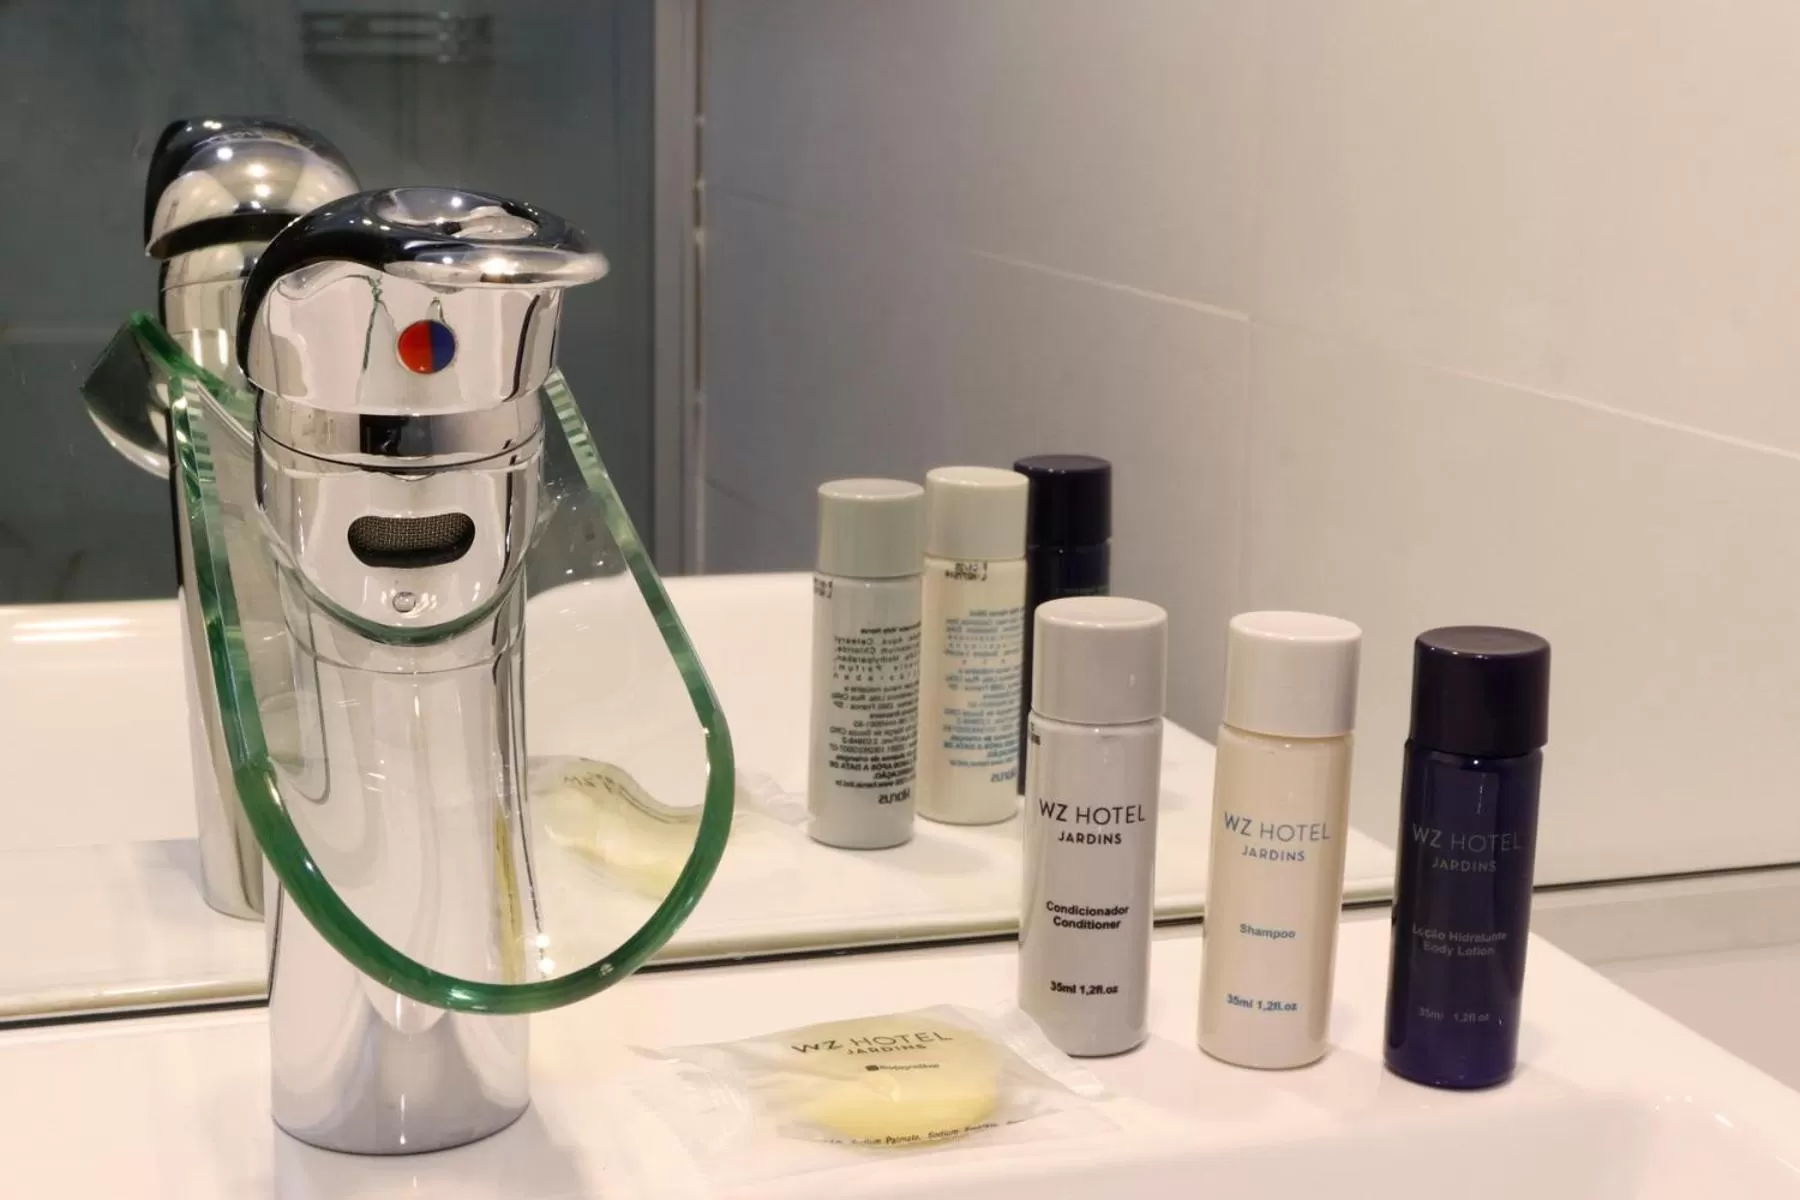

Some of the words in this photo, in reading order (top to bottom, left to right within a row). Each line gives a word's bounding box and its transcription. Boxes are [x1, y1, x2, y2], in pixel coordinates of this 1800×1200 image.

[1039, 798, 1068, 822] WZ
[1076, 804, 1146, 826] HOTEL
[1224, 811, 1251, 837] WZ
[1260, 823, 1331, 843] HOTEL
[1058, 831, 1122, 845] JARDINS
[1413, 823, 1442, 848] WZ
[1451, 832, 1522, 853] HOTEL
[1242, 845, 1305, 862] JARDINS
[1432, 856, 1496, 873] JARDINS
[1046, 900, 1130, 917] Condicionador
[1053, 916, 1121, 930] Conditioner
[1239, 923, 1295, 940] Shampoo
[1050, 981, 1076, 994] 35ml
[1227, 994, 1253, 1009] 35ml
[791, 1040, 844, 1053] WZ
[850, 1031, 954, 1047] HOTEL
[848, 1043, 927, 1055] JARDINS
